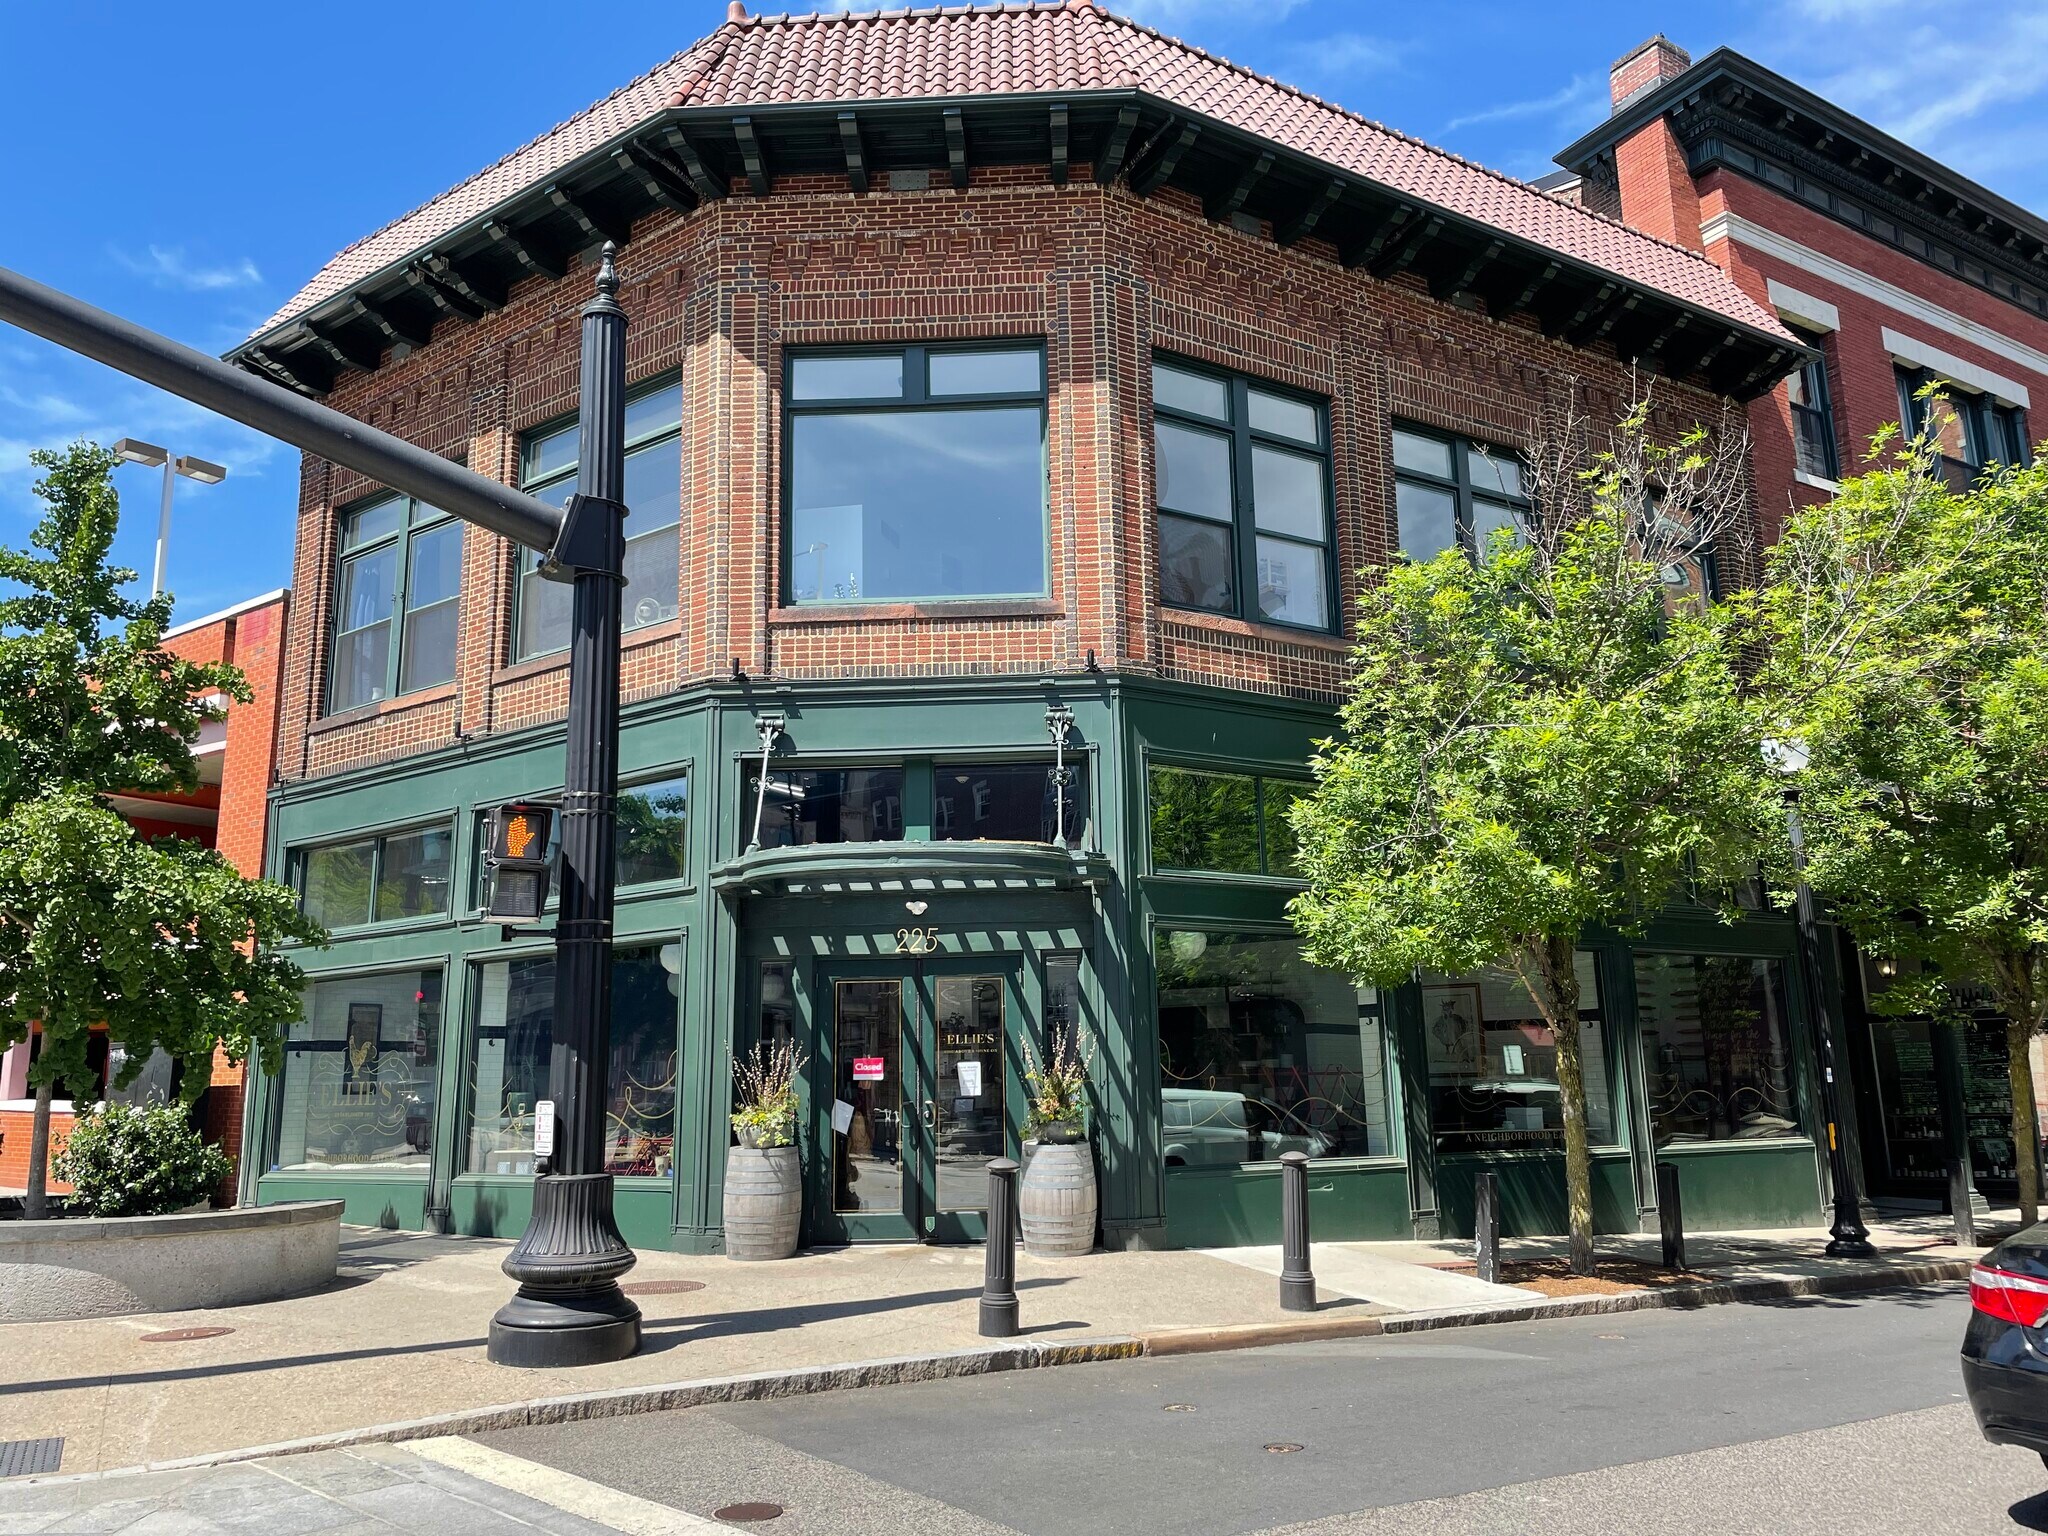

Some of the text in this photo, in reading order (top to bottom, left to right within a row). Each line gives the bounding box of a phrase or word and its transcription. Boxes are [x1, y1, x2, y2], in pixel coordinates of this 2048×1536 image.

[894, 927, 939, 953] 225
[947, 1033, 995, 1045] ELLIE'S
[854, 1062, 882, 1071] Closed
[318, 1080, 392, 1107] ELLIE'S
[1465, 1133, 1472, 1143] A
[1474, 1131, 1551, 1142] NEIGHBORHOOD
